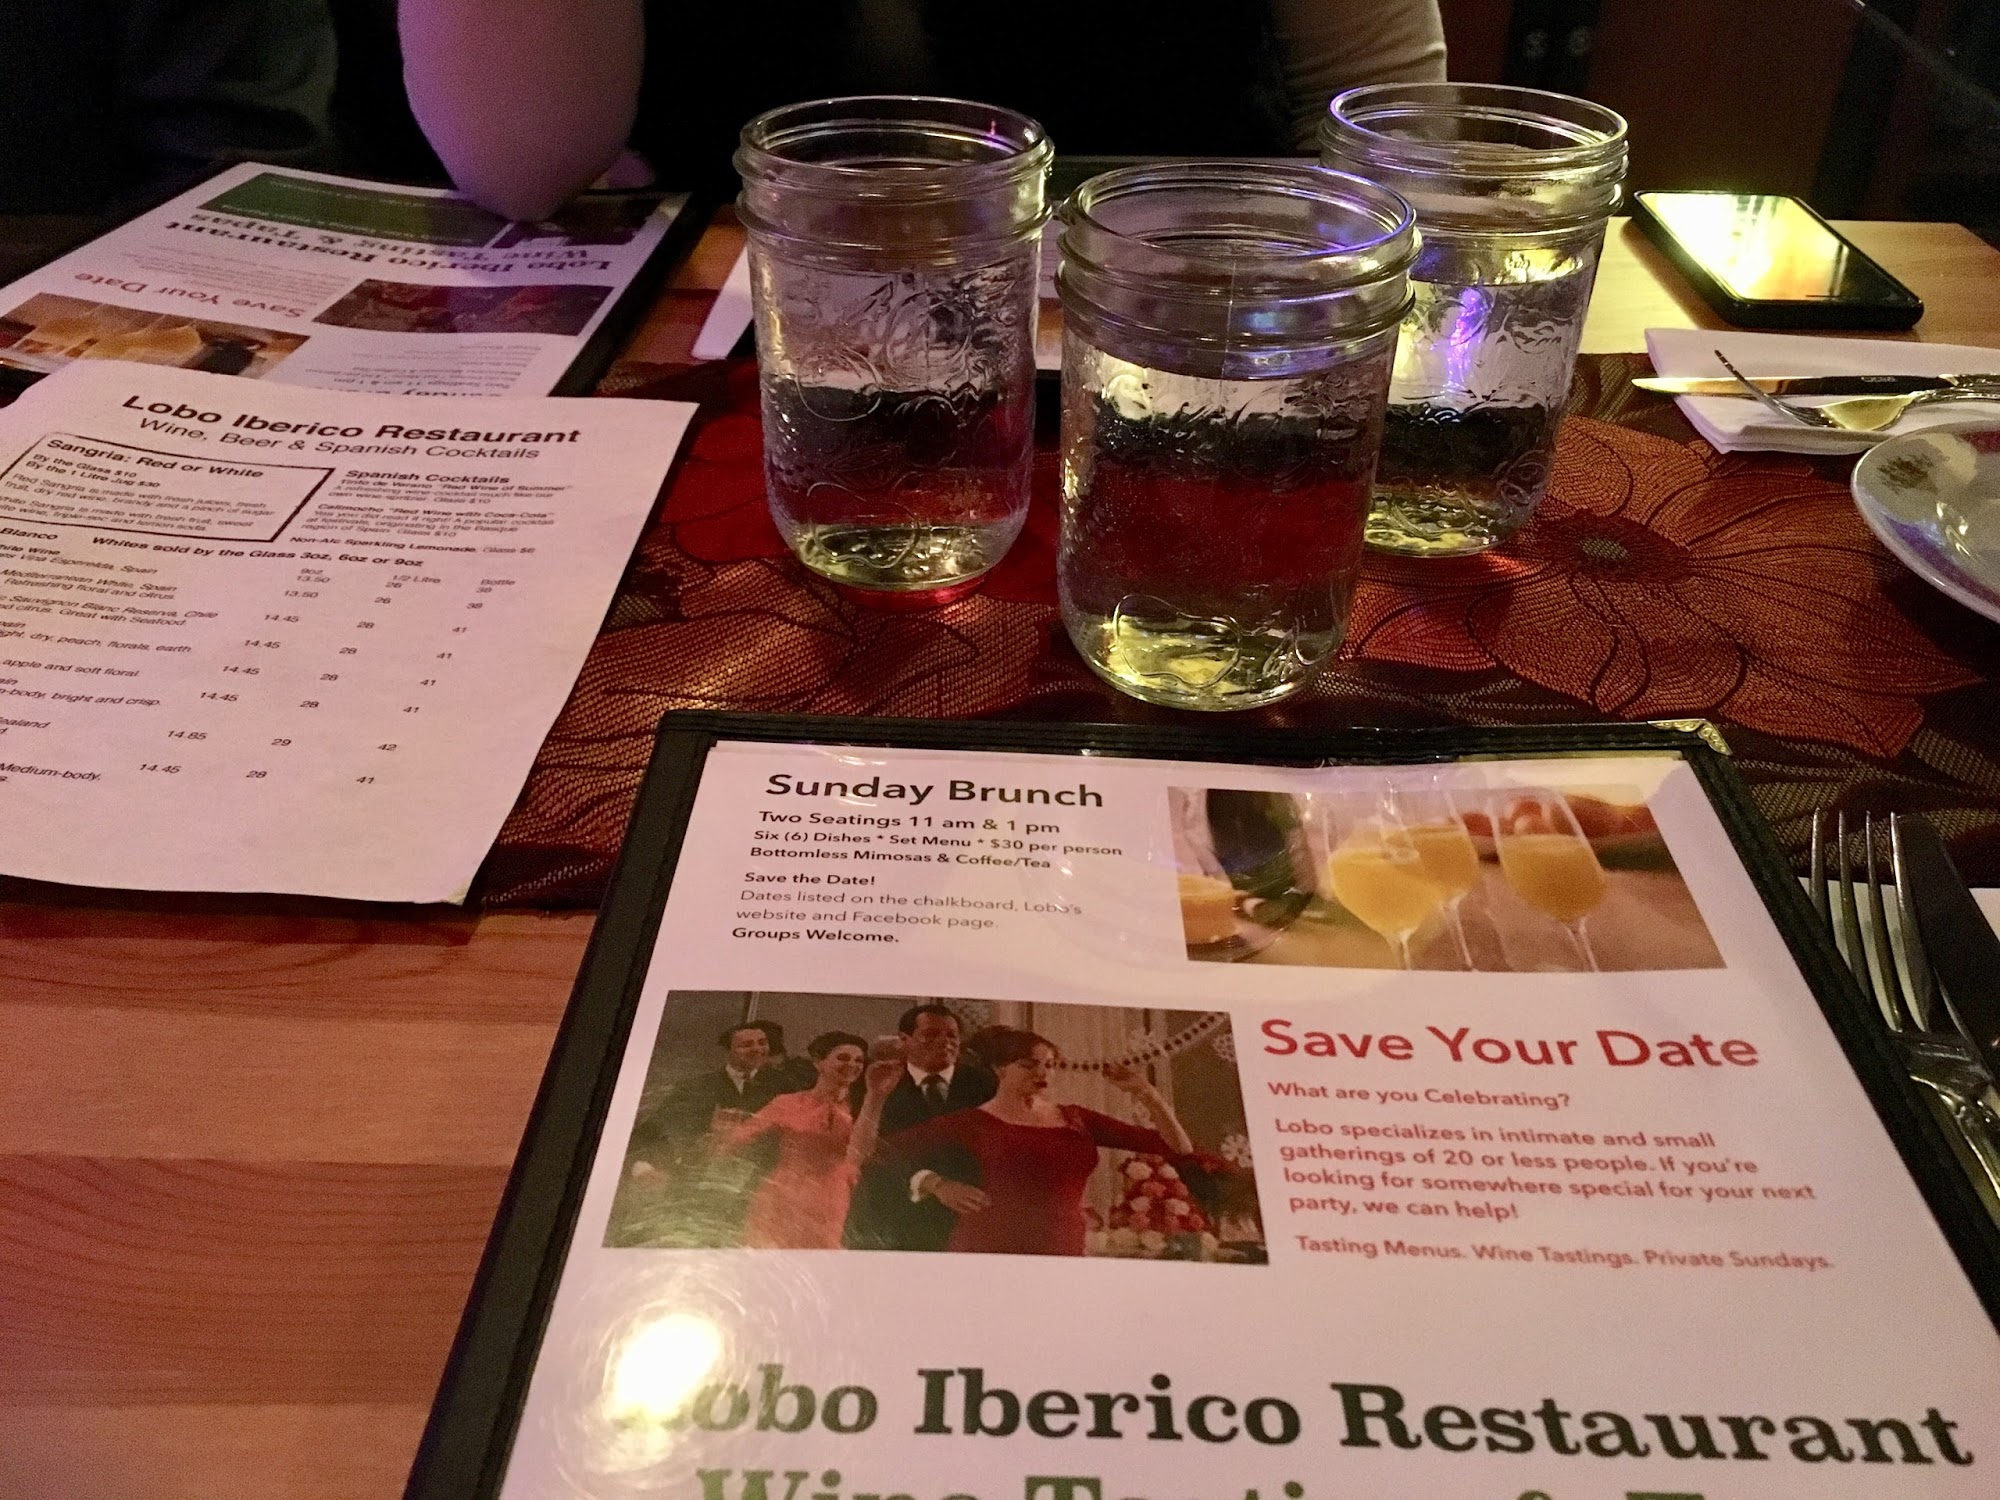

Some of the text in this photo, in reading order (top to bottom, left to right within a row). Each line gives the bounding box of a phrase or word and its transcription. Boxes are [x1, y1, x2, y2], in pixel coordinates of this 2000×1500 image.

[165, 222, 378, 263] Restaurant
[74, 272, 305, 318] Save Your Date
[122, 395, 582, 443] Lobo Iberico Restaurant
[219, 432, 283, 448] Beer
[288, 440, 306, 451] &
[315, 441, 418, 456] Spanish
[426, 446, 540, 459] Cocktails
[26, 461, 43, 470] By
[46, 465, 66, 474] the
[80, 472, 108, 481] Litre
[111, 478, 135, 486] Jug
[33, 454, 137, 478] By the Glass $10
[136, 457, 178, 470] Red
[181, 464, 203, 472] or
[209, 466, 264, 478] White
[346, 470, 510, 483] Spanish Cocktails
[0, 527, 58, 540] Blanco
[344, 539, 405, 549] Sparkling
[92, 537, 148, 549] Whites
[152, 545, 190, 553] sold
[193, 548, 214, 557] by
[249, 550, 296, 558] Glass
[338, 554, 368, 562] 6oz
[394, 558, 424, 567] 9oz
[2, 659, 42, 668] apple
[44, 663, 73, 671] and
[51, 692, 94, 703] bright
[200, 692, 420, 714] 14.45 28 41
[167, 730, 398, 752] 14.85 29 42
[139, 764, 376, 785] 14.45 28 41
[766, 773, 1104, 808] Sunday Brunch
[759, 810, 1060, 835] Two Seatings 11 am & 1 pm
[754, 830, 1122, 856] Six (6) Dishes Set Menu $30 per person
[750, 847, 1051, 869] Bottomless Mimosas & Coffee/Tea
[744, 872, 875, 886] Save the Date!
[740, 890, 791, 902] Dates
[797, 891, 845, 904] listed
[851, 895, 872, 904] on
[879, 894, 907, 905] the
[736, 909, 999, 931] website and Facebook page.
[732, 927, 899, 943] Groups Welcome.
[1260, 1018, 1759, 1068] Save Your Date
[1268, 1081, 1570, 1110] What are you Celebrating?
[1276, 1118, 1715, 1148] Lobo specializes in intimate and small
[1280, 1143, 1757, 1176] gatherings of 20 or less people. If you're
[1285, 1168, 1815, 1202] looking for somewhere special for your next
[1289, 1196, 1518, 1223] party, we can help!
[1297, 1235, 1379, 1259] Tasting
[1472, 1245, 1534, 1263] Wine
[1644, 1249, 1724, 1267] Private
[610, 1362, 1975, 1467] obo Iberico Restaurant
